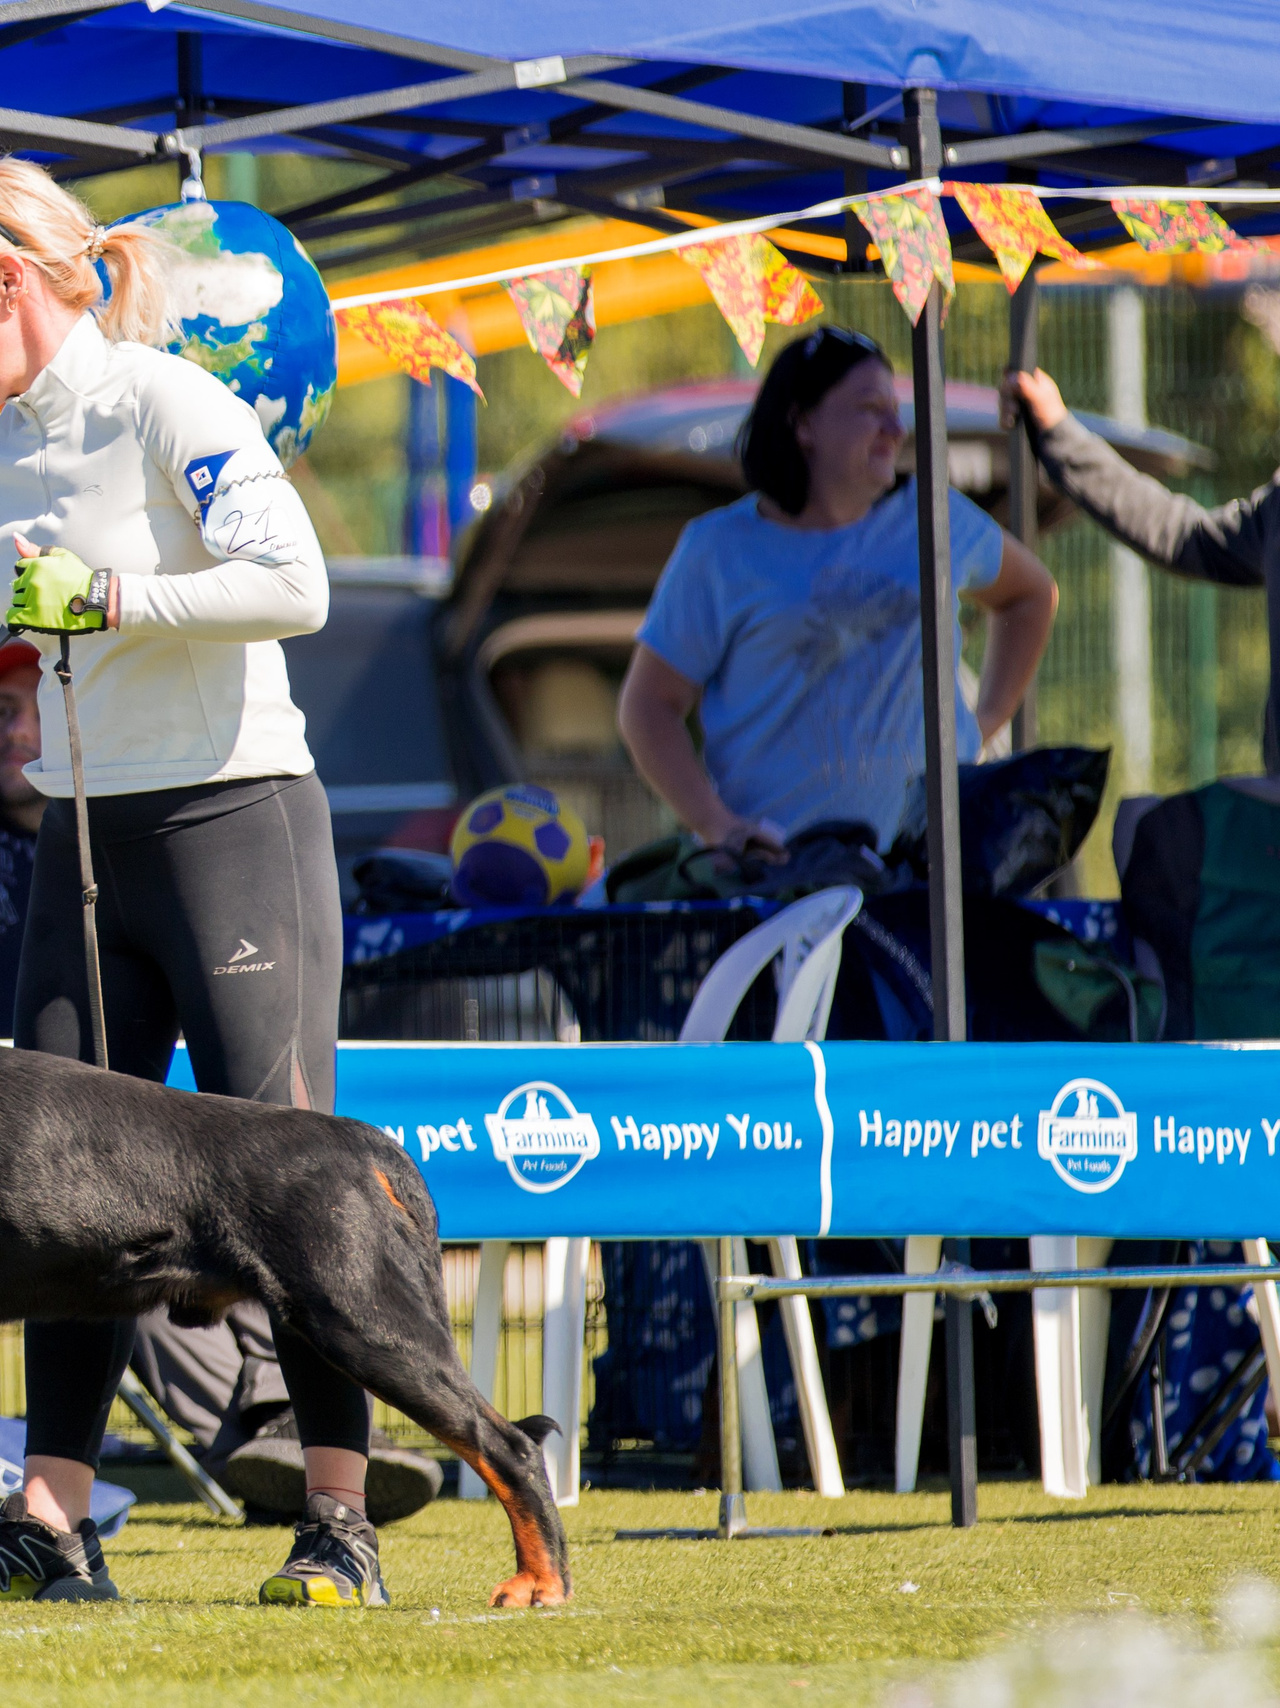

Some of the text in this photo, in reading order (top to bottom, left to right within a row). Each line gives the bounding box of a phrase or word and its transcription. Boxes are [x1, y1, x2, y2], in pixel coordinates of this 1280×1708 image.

[223, 500, 278, 555] 21
[213, 961, 276, 975] DEMIX
[416, 1117, 478, 1162] pet
[501, 1125, 589, 1150] Farmina
[610, 1113, 803, 1160] Happy You.
[858, 1109, 1024, 1158] Happy pet
[1049, 1122, 1127, 1148] Farmina
[1153, 1115, 1252, 1166] Happy
[522, 1158, 538, 1171] Pet
